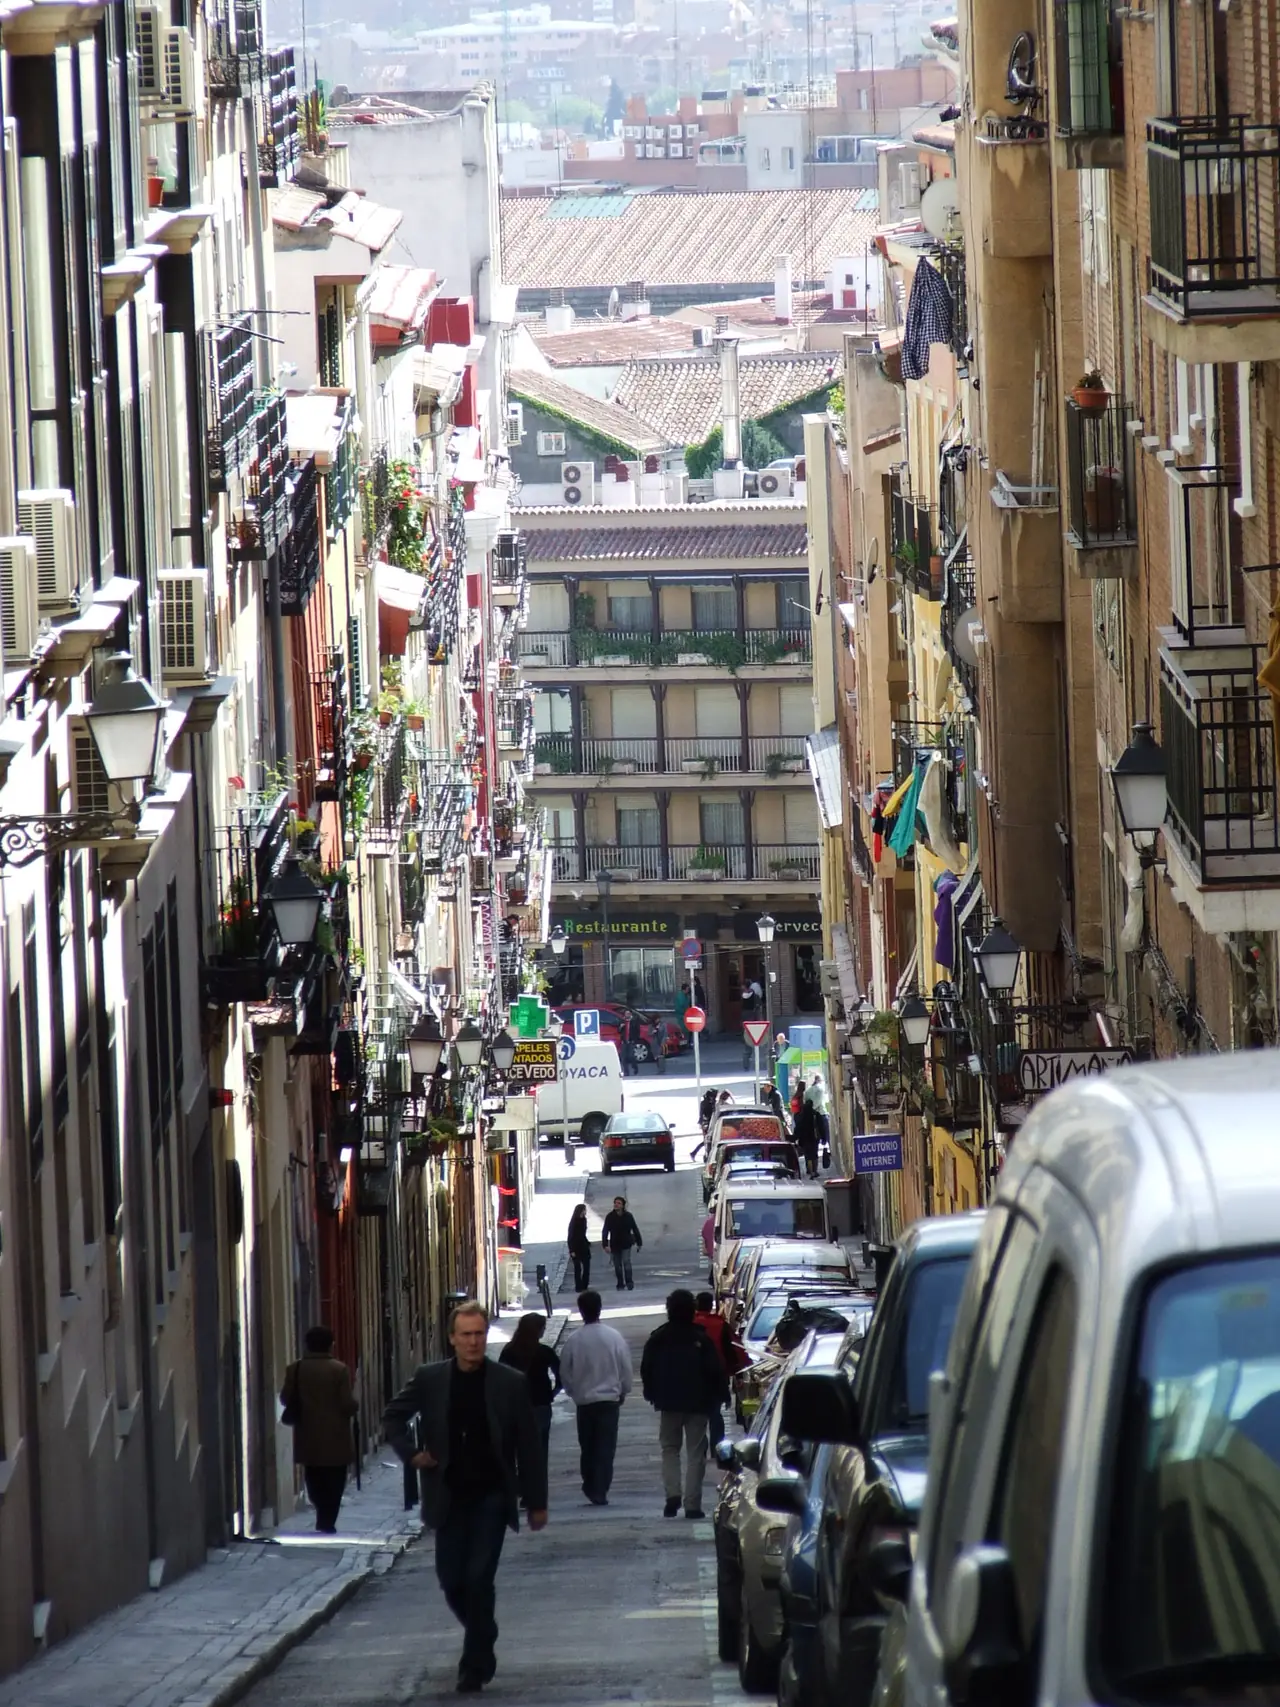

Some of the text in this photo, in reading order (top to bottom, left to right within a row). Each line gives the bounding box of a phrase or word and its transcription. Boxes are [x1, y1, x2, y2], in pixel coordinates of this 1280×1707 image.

[564, 919, 668, 935] Restaurante
[775, 922, 823, 932] ervec
[580, 1013, 592, 1033] P
[516, 1043, 550, 1053] PELES
[513, 1054, 553, 1063] NTADOS
[507, 1064, 556, 1079] CEVEDO
[560, 1066, 609, 1080] OYACA
[857, 1140, 898, 1154] LOCUTORIO
[861, 1154, 897, 1168] INTERNET
